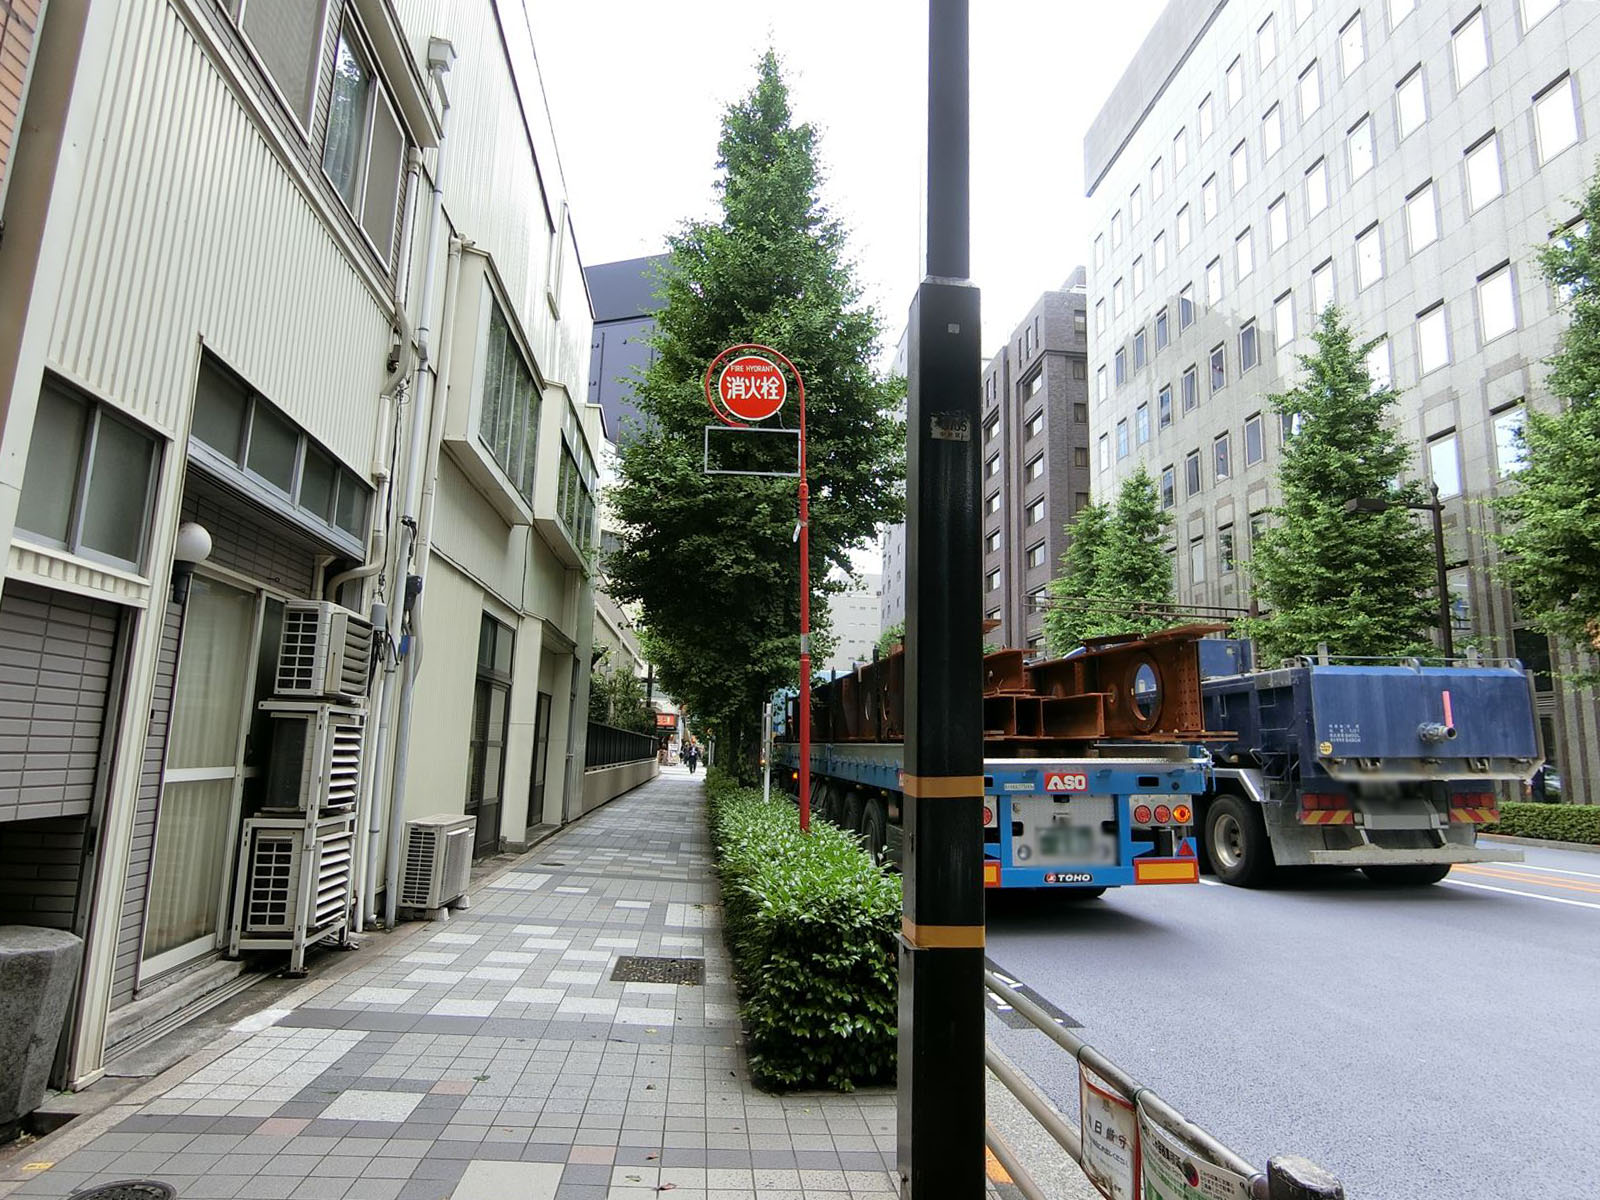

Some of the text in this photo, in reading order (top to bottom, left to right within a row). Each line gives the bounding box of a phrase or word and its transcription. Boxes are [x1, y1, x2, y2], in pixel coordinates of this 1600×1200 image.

[726, 376, 780, 400] 消火栓
[1047, 775, 1086, 790] ASO
[1058, 874, 1090, 882] TOHO
